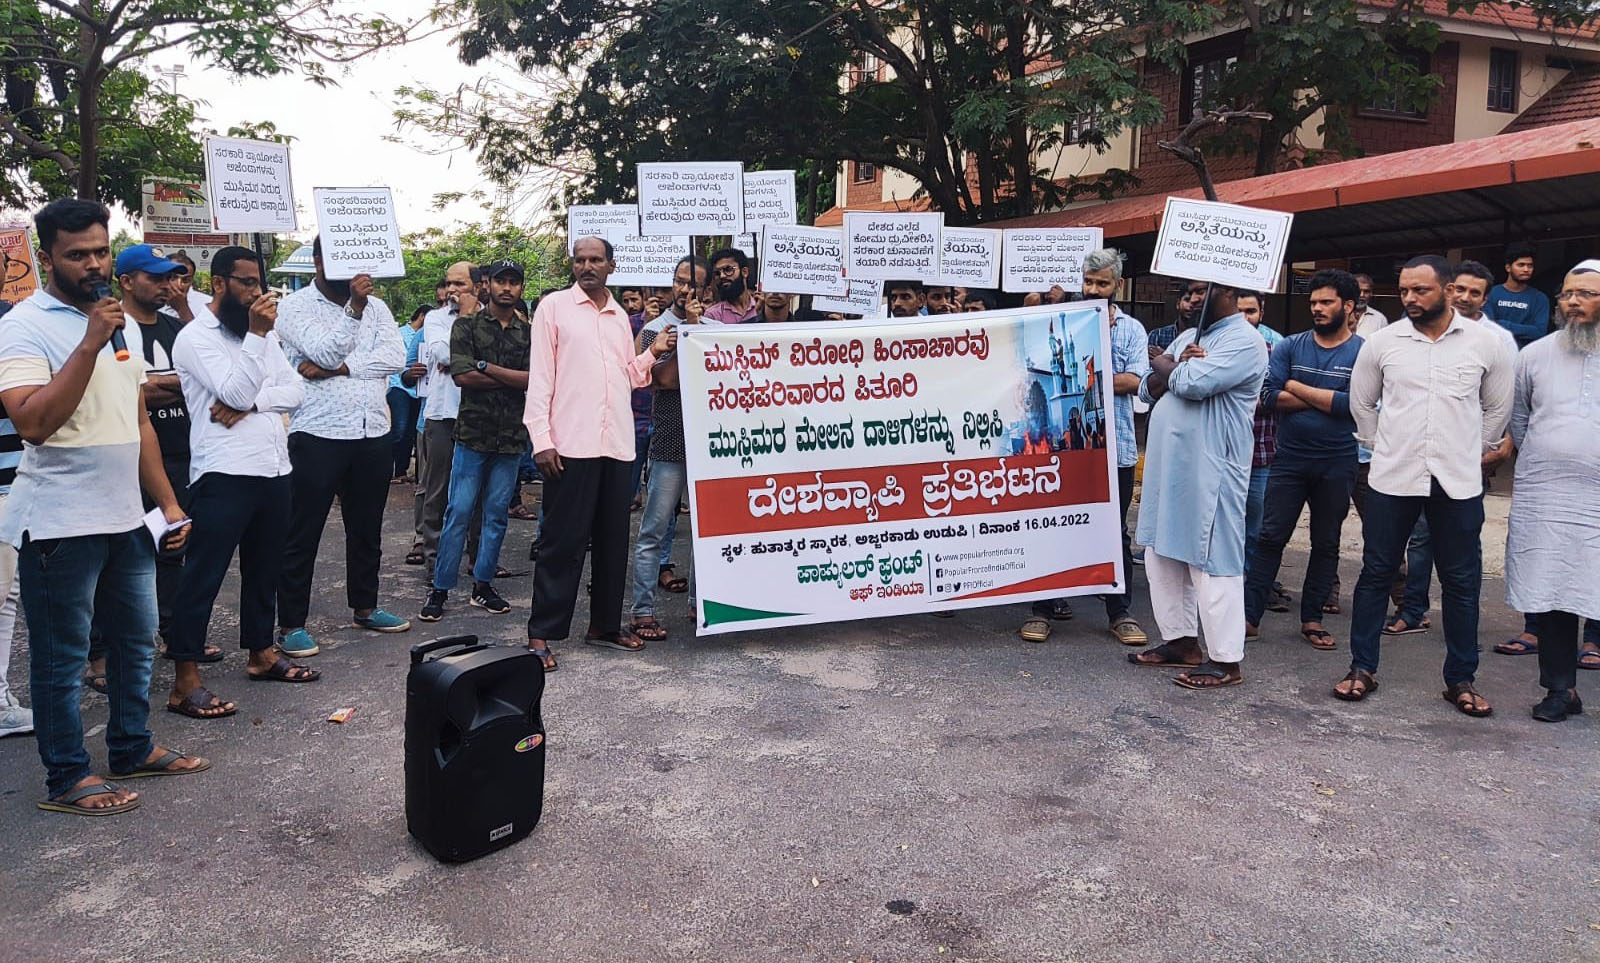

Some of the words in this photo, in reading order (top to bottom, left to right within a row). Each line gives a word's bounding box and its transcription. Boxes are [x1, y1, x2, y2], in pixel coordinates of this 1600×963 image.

[215, 148, 243, 159] ಸರಕಾರಿ
[645, 171, 679, 181] ಸರಕಾರಿ
[681, 172, 735, 182] ಪ್ರಾಯೋಜಿತ
[657, 181, 723, 195] ಅಜೆಂಡಾಗಳನ್ನು
[323, 196, 387, 206] ಸಂಘಪರಿವಾರದ
[651, 197, 697, 211] ಮುಸ್ಲಿಮರ
[326, 205, 387, 216] ಅಜೆಂಡಾಗಳು
[645, 211, 695, 223] ಹೇರುವುದು
[697, 212, 736, 225] ಅನ್ಯಾಯ
[1213, 215, 1267, 230] ಸಮುದಾಯದ
[329, 223, 389, 236] ಮುಸ್ಲಿಮರ
[867, 222, 894, 231] ದೇಶದ
[333, 237, 390, 250] ಬದುಕನ್ನು
[853, 233, 886, 243] ಕೋಮು
[330, 249, 396, 263] ಕಸಿಯುತ್ತಿದೆ
[853, 246, 885, 255] ಸರಕಾರ
[887, 246, 934, 255] ಚುನಾವಣೆಗೆ
[1168, 238, 1199, 250] ಸರಕಾರ
[1200, 242, 1270, 262] ಪ್ರಾಯೋಜಿತವಾಗಿ
[1174, 250, 1211, 263] ಕಸಿಯಲು
[855, 258, 887, 267] ತಯಾರಿ
[773, 269, 802, 280] ಕಸಿಯಲು
[704, 341, 780, 381] ಮುಸ್ಲಿಮ್
[790, 337, 864, 368] ವಿರೋಧಿ
[873, 327, 990, 362] ಹಿಂಸಾಚಾರವು
[708, 373, 845, 413] ಸಂಘಪರಿವಾರದ
[854, 371, 918, 401] ಪಿತೂರಿ
[708, 418, 786, 468] ಮುಸ್ಲಿಮರ
[795, 414, 855, 452] ಮೇಲಿನ
[863, 407, 955, 455] ದಾಳಿಗಳನ್ನು
[962, 409, 1003, 450] ನಿಲ್ಲಿಸಿ
[748, 472, 905, 522] ದೇಶವ್ಯಾಪಿ
[922, 455, 1061, 517] ಪ್ರತಿಭಟನೆ
[721, 543, 746, 563] ಸ್ಥಳ:
[750, 538, 806, 557] ಹುತಾತ್ಮರ
[810, 534, 851, 554] ಸ್ಮಾರಕ,
[855, 528, 920, 549] ಅಜ್ಜರಕಾಡು
[923, 524, 968, 539] ಉಡುಪಿ
[979, 519, 1021, 535] ದಿನಾಂಕ
[1024, 513, 1090, 531] 16.04.2022
[942, 547, 1025, 561] www.popularfrontindia.org
[797, 553, 874, 589] ಪಾಪ್ಯುಲರ್
[878, 549, 923, 584] ಫ್ರಂಟ್
[849, 584, 874, 602] ಆಫ್
[876, 580, 925, 599] ಇಂಡಿಯಾ
